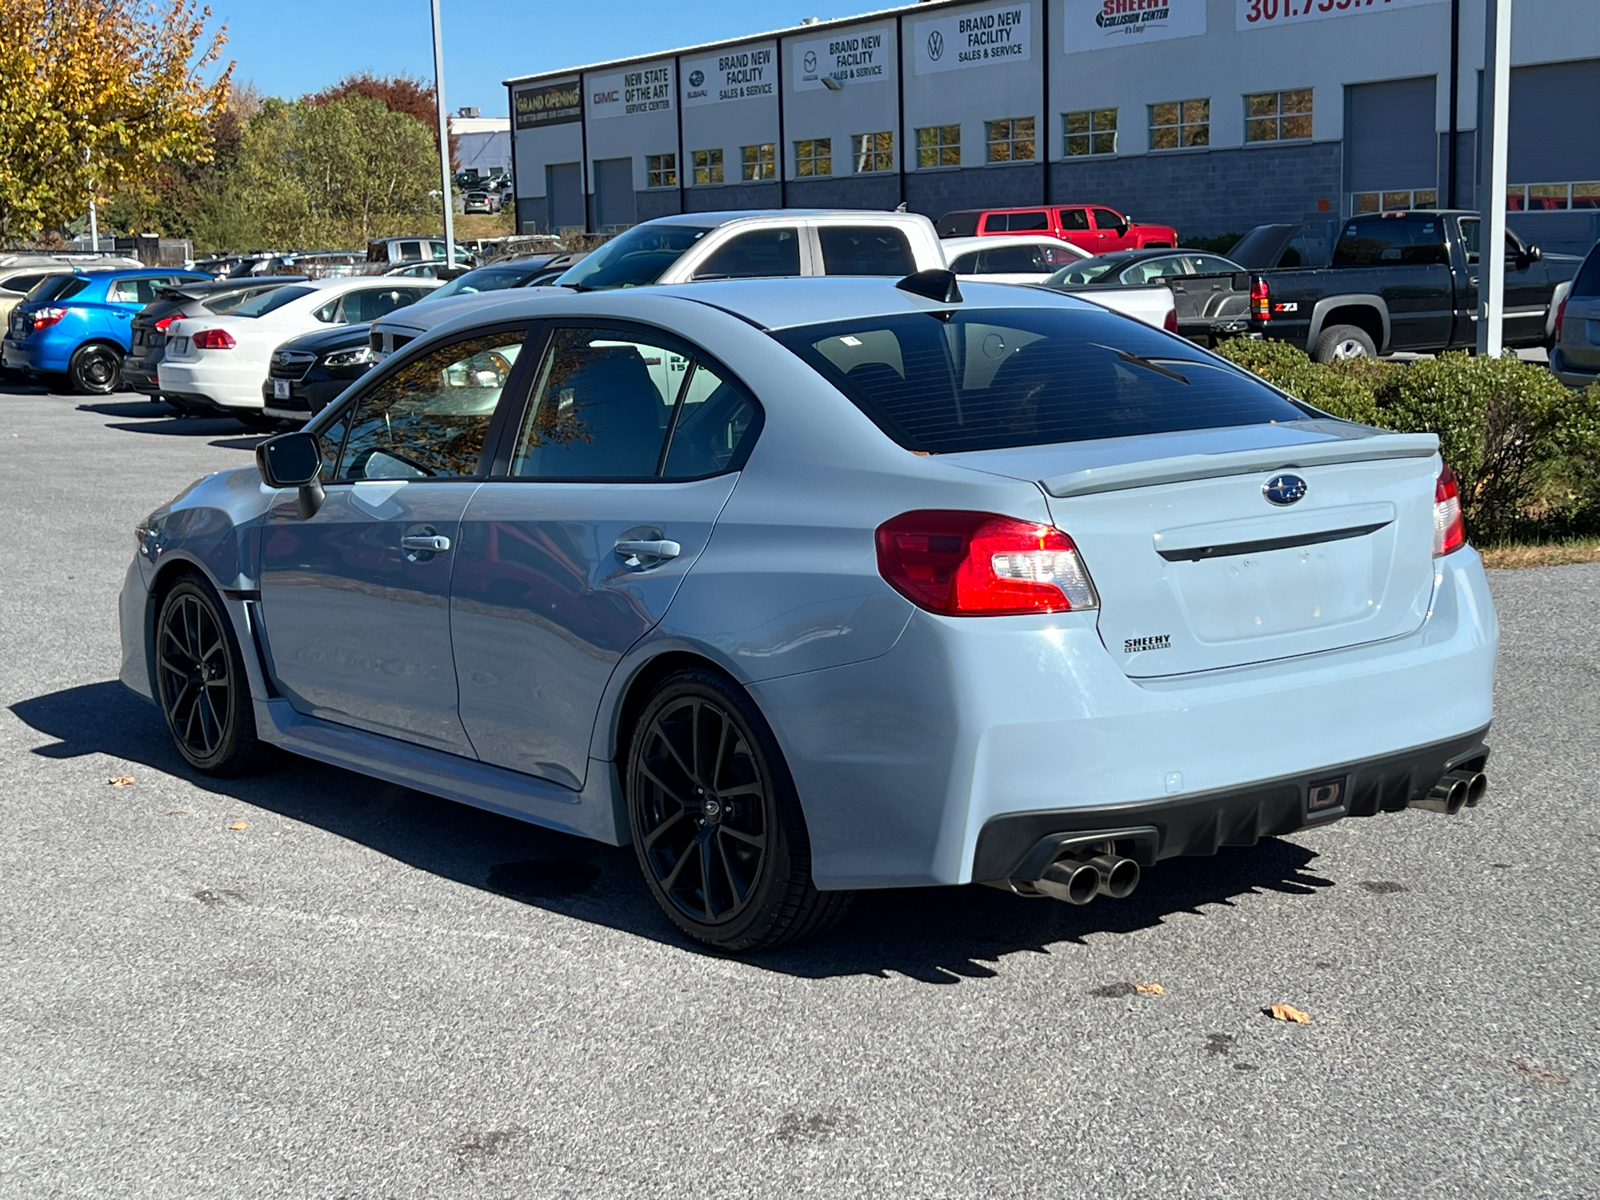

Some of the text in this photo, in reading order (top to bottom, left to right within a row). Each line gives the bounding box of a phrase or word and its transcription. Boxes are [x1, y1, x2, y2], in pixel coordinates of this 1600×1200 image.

[959, 10, 1021, 33] BRAND NEW
[1103, 8, 1169, 28] COLLISION CENTER
[829, 35, 881, 55] BRAND NEW
[968, 28, 1012, 47] FACILITY
[719, 50, 771, 71] BRAND NEW
[837, 50, 873, 68] FACILITY
[959, 44, 1022, 62] SALES & SERVICE
[625, 68, 668, 87] NEW STATE
[727, 67, 763, 85] FACILITY
[849, 69, 854, 79] &
[856, 65, 882, 78] SERVICE
[594, 90, 619, 104] GMC
[625, 84, 669, 102] OF THE ART
[719, 83, 772, 100] SALES & SERVICE
[517, 90, 580, 112] GRAND OPENING
[626, 100, 670, 114] SERVICE CENTER
[1275, 302, 1297, 311] Z71
[1124, 634, 1171, 648] SHEEHY
